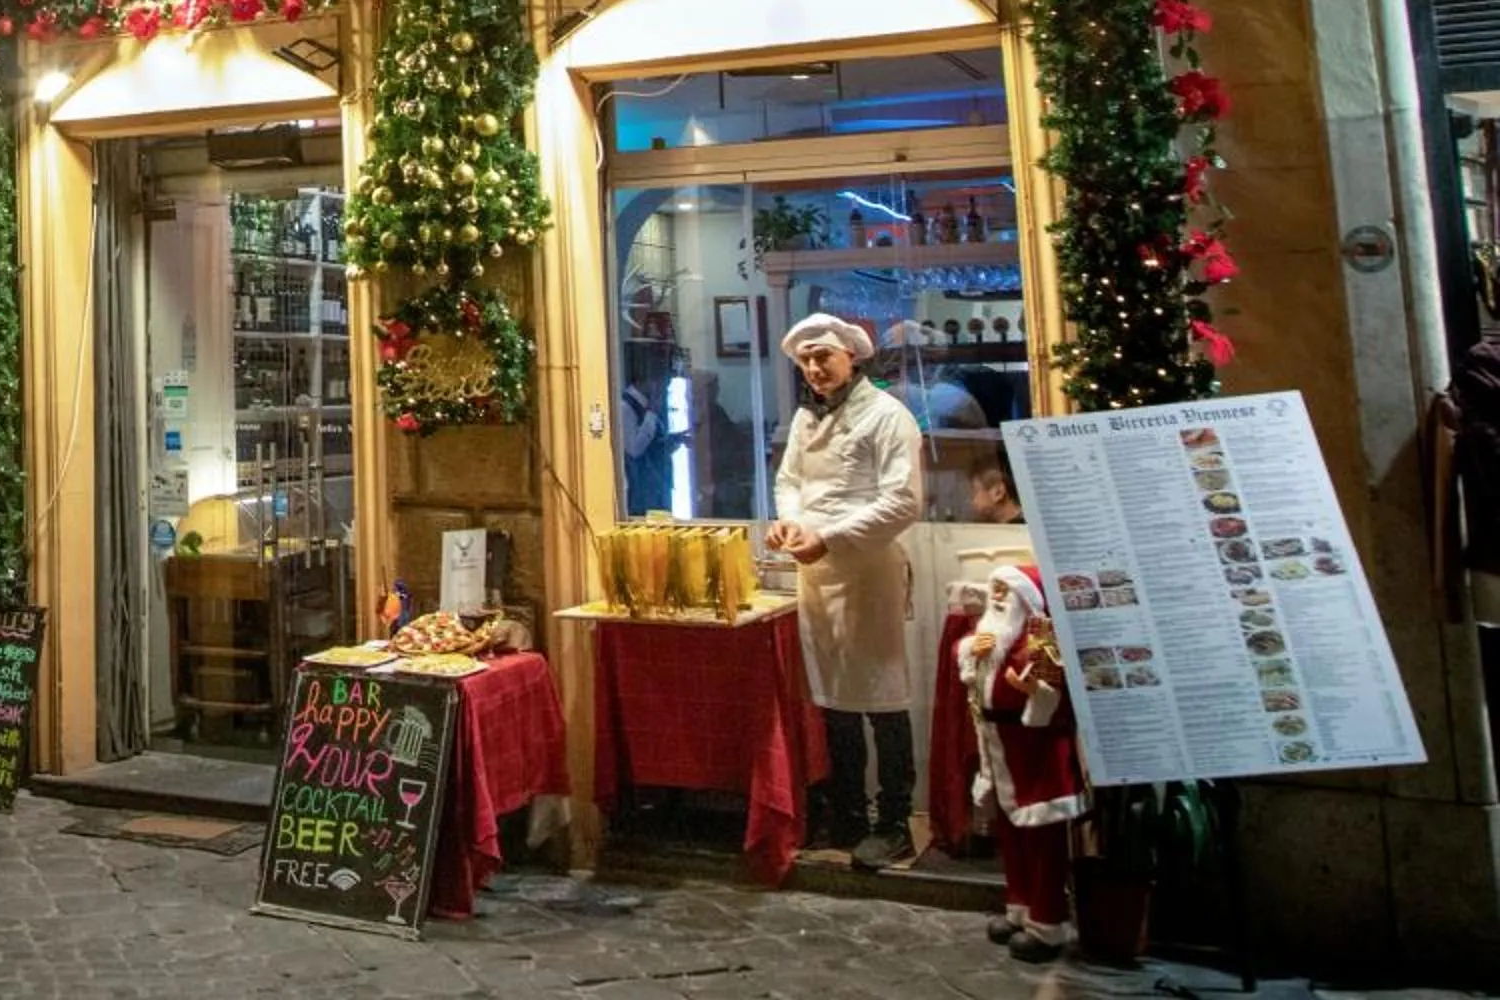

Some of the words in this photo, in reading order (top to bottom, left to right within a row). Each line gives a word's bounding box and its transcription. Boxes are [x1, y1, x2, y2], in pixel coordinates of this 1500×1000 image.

[1047, 423, 1099, 438] Antica
[1184, 405, 1258, 425] Viennese
[332, 674, 381, 709] BAR
[292, 680, 392, 743] happy
[281, 783, 389, 823] COCKTAIL
[276, 814, 364, 857] BEER
[273, 859, 331, 889] FREE
